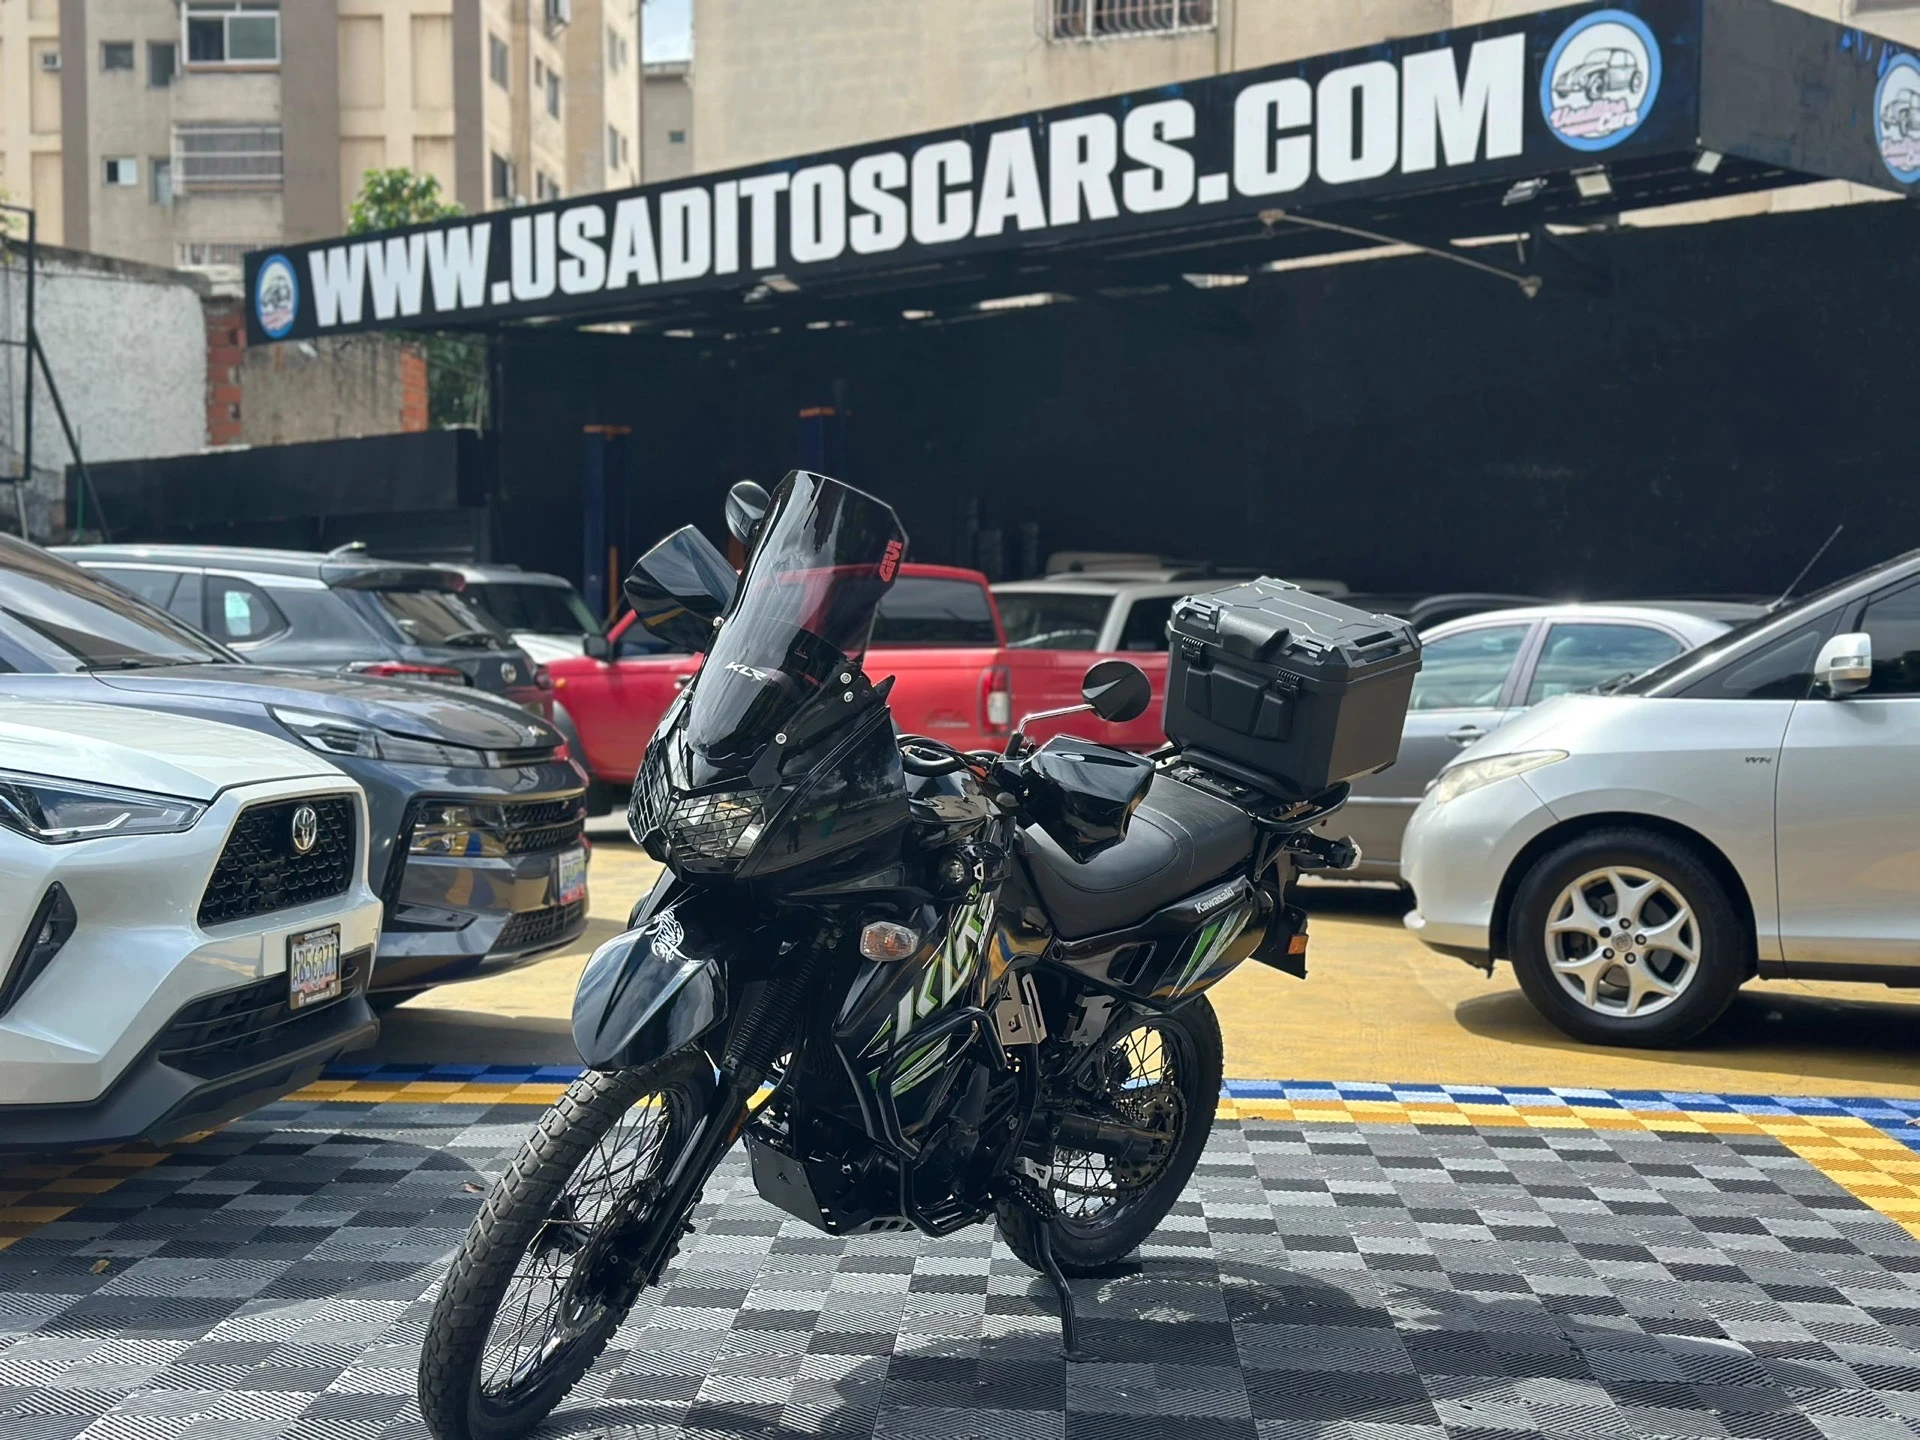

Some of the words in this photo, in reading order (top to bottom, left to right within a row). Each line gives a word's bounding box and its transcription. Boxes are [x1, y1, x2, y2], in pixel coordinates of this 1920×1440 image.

[308, 32, 1526, 327] WWW.USADITOSCARS.COM
[879, 539, 902, 582] GIVI
[724, 661, 768, 681] KLR
[1194, 886, 1235, 914] Kawasaki
